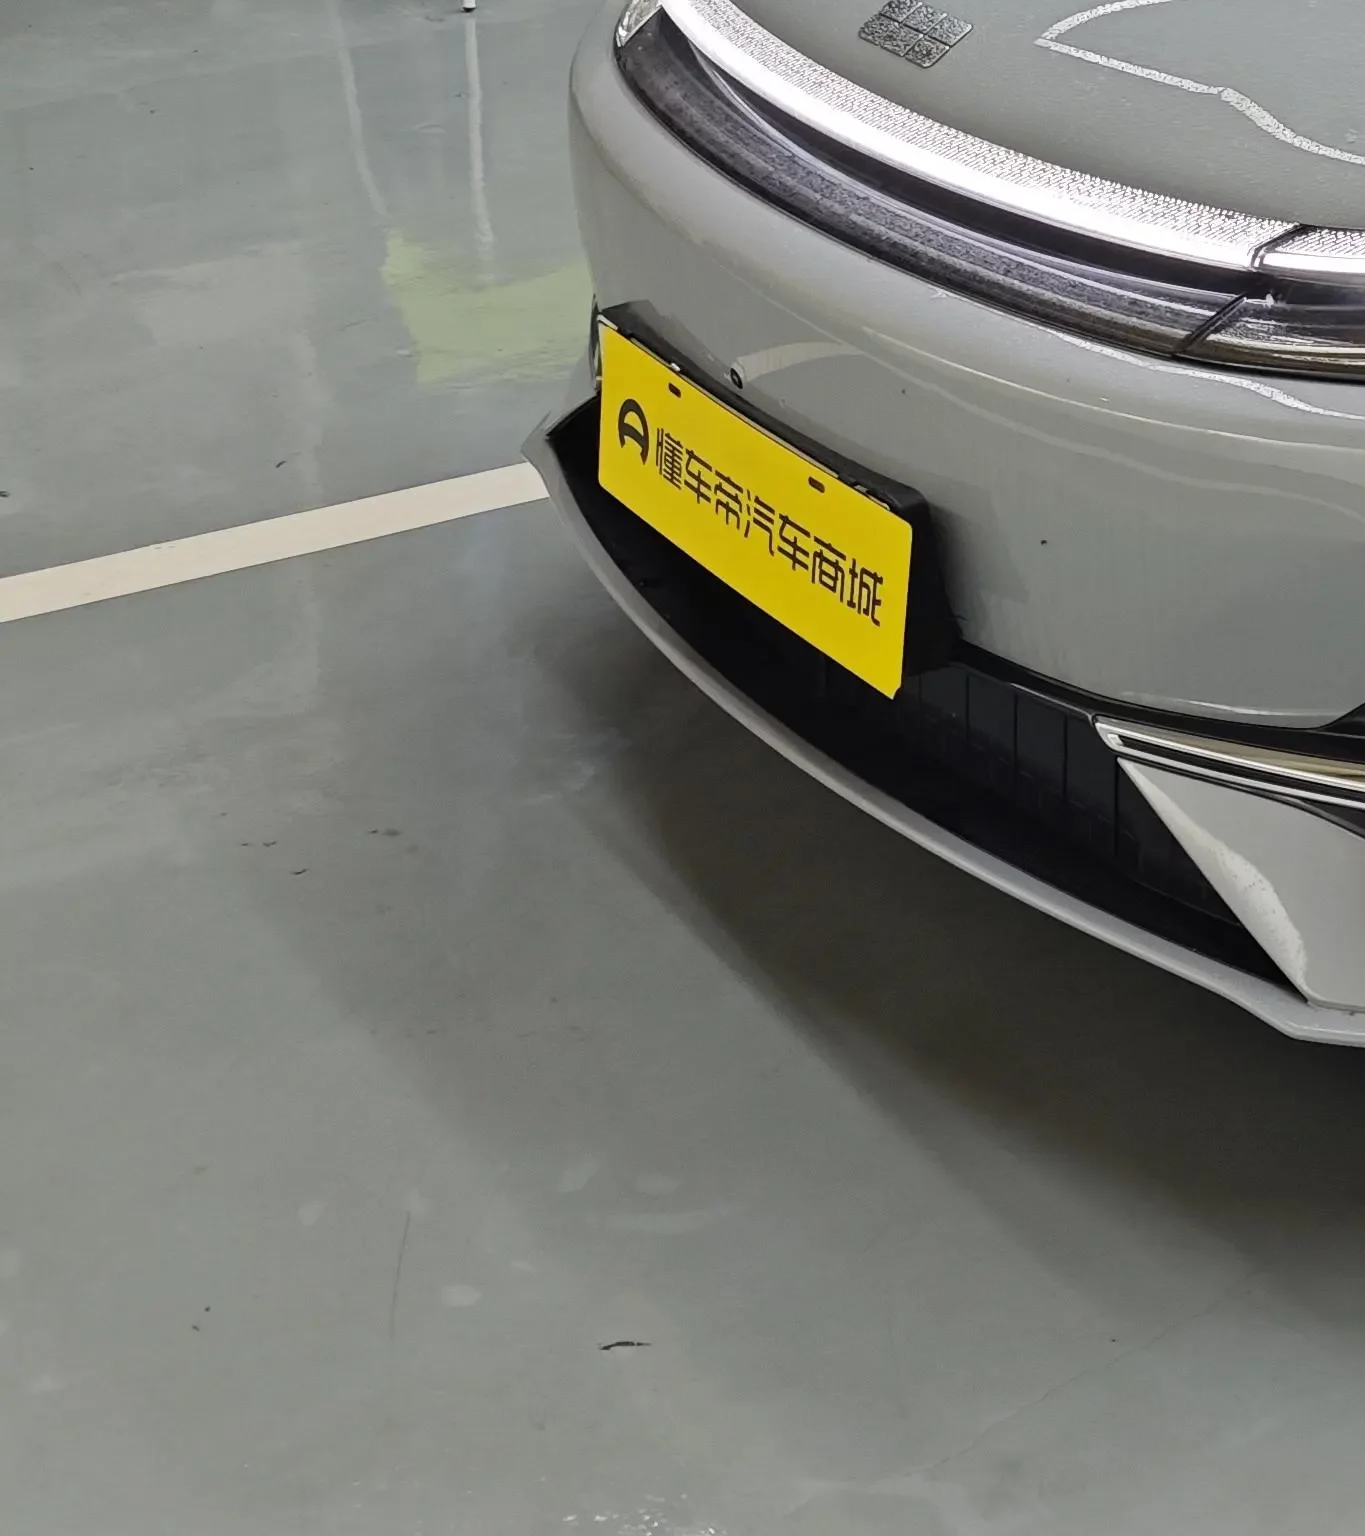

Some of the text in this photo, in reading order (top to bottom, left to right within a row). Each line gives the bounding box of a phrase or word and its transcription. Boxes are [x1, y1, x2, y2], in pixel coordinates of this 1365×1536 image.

[655, 427, 884, 627] 懂车帝汽车商城
